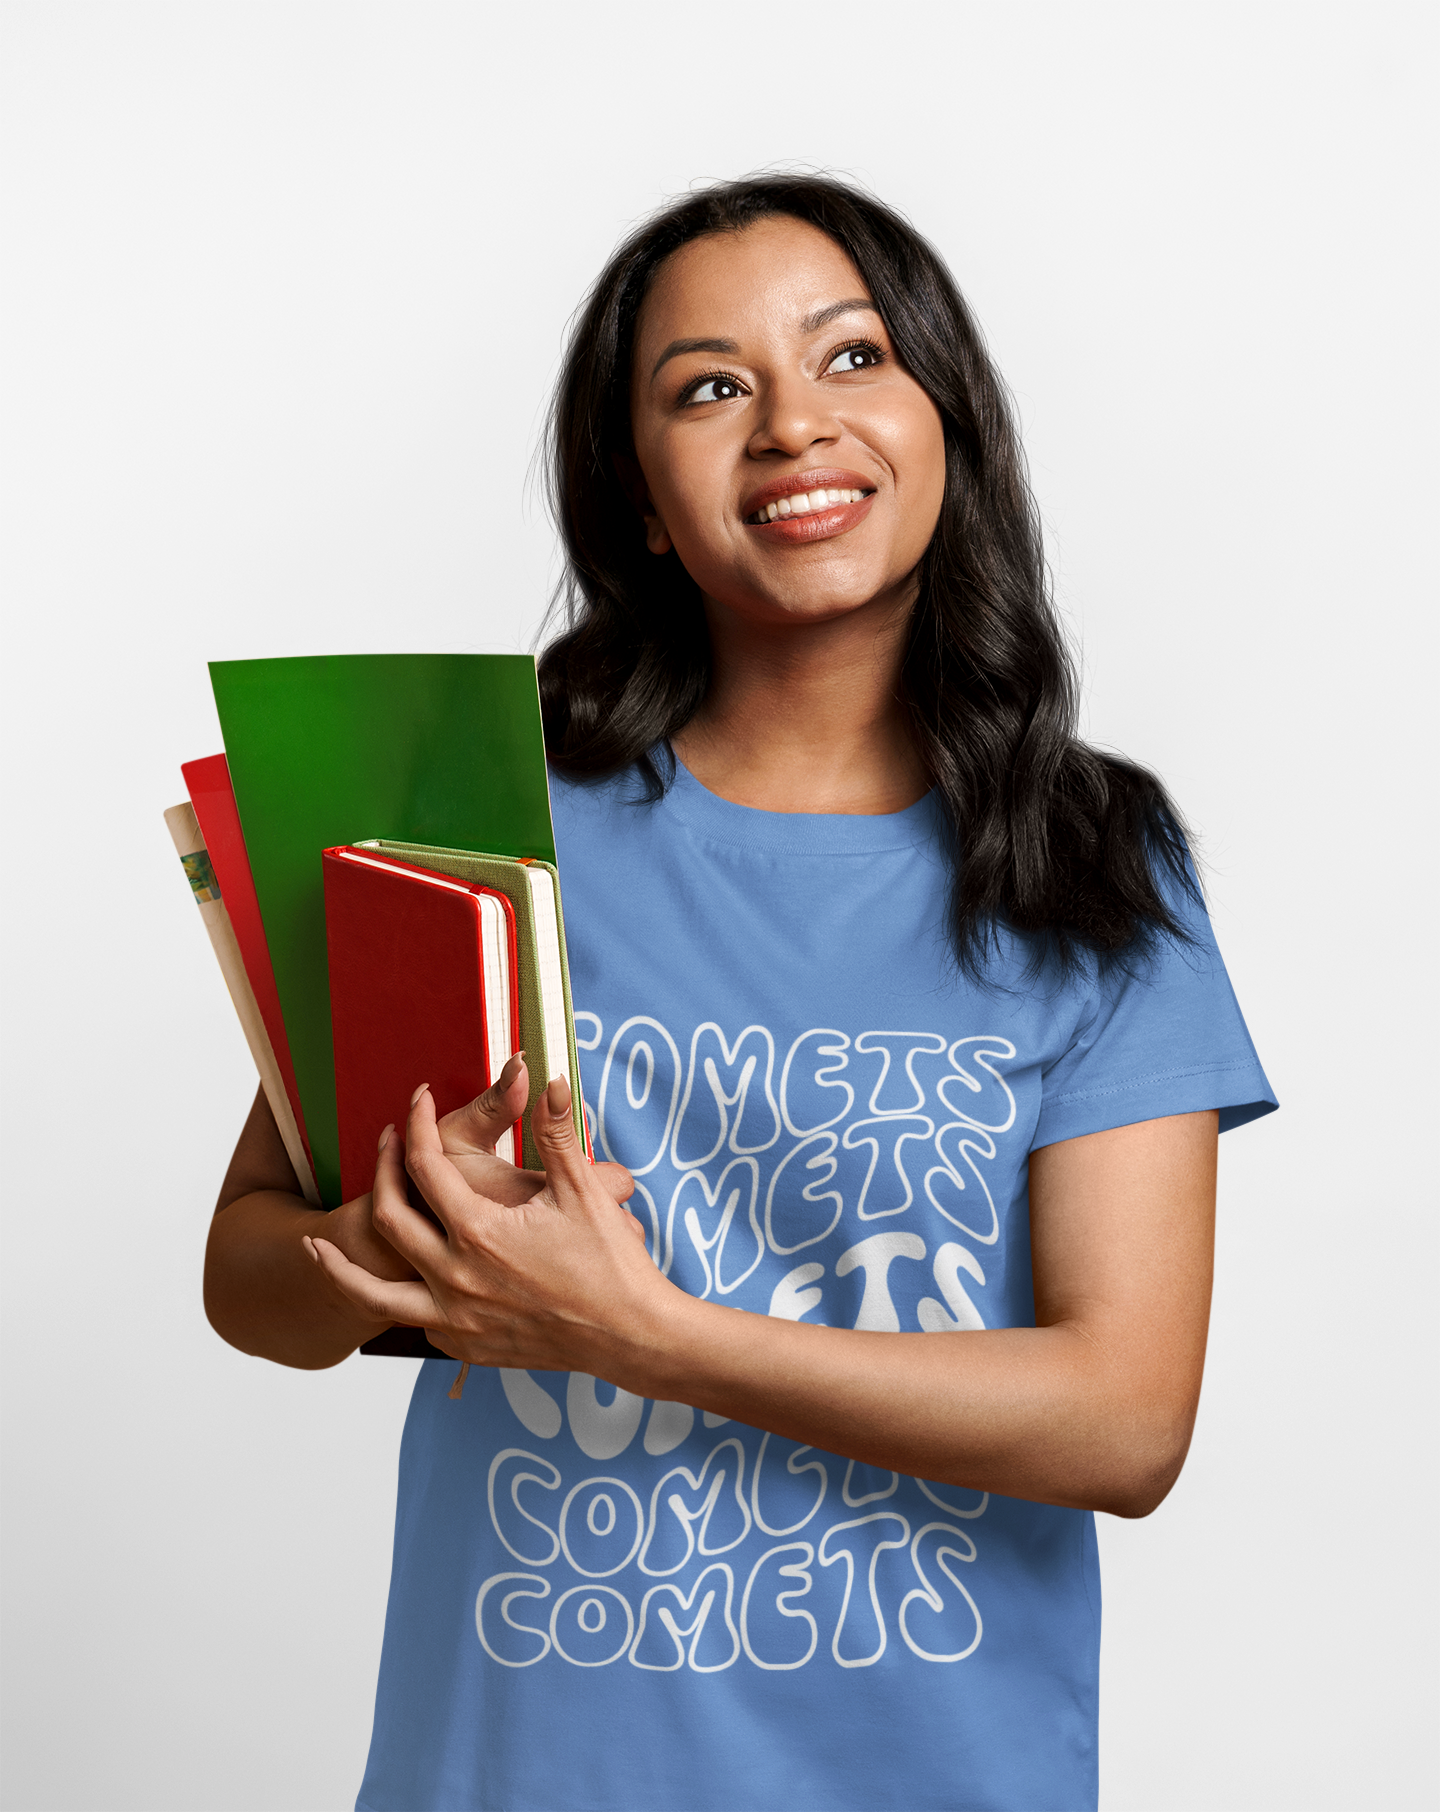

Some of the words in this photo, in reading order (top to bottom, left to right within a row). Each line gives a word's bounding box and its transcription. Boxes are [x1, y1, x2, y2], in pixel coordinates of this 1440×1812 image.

[622, 1116, 998, 1300] METS
[487, 1431, 989, 1577] COME
[475, 1511, 983, 1672] COMETS
